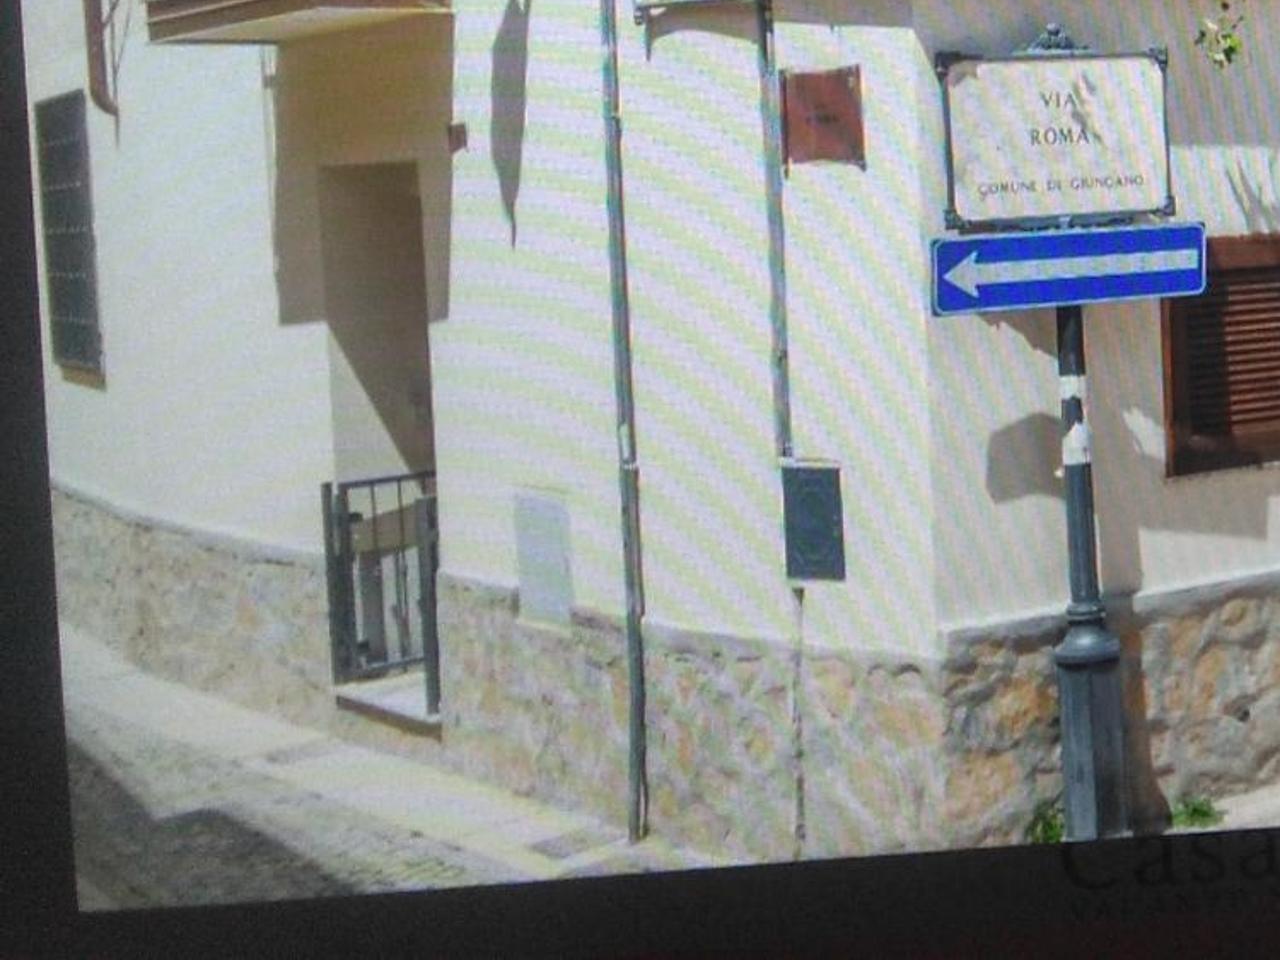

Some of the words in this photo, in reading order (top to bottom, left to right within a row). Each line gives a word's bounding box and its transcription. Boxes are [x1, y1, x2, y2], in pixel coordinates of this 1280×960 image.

[1040, 92, 1077, 109] VIA
[1030, 126, 1090, 145] ROMA
[977, 180, 1038, 197] COMUNE
[1046, 179, 1062, 192] DI
[1060, 831, 1280, 891] Casa
